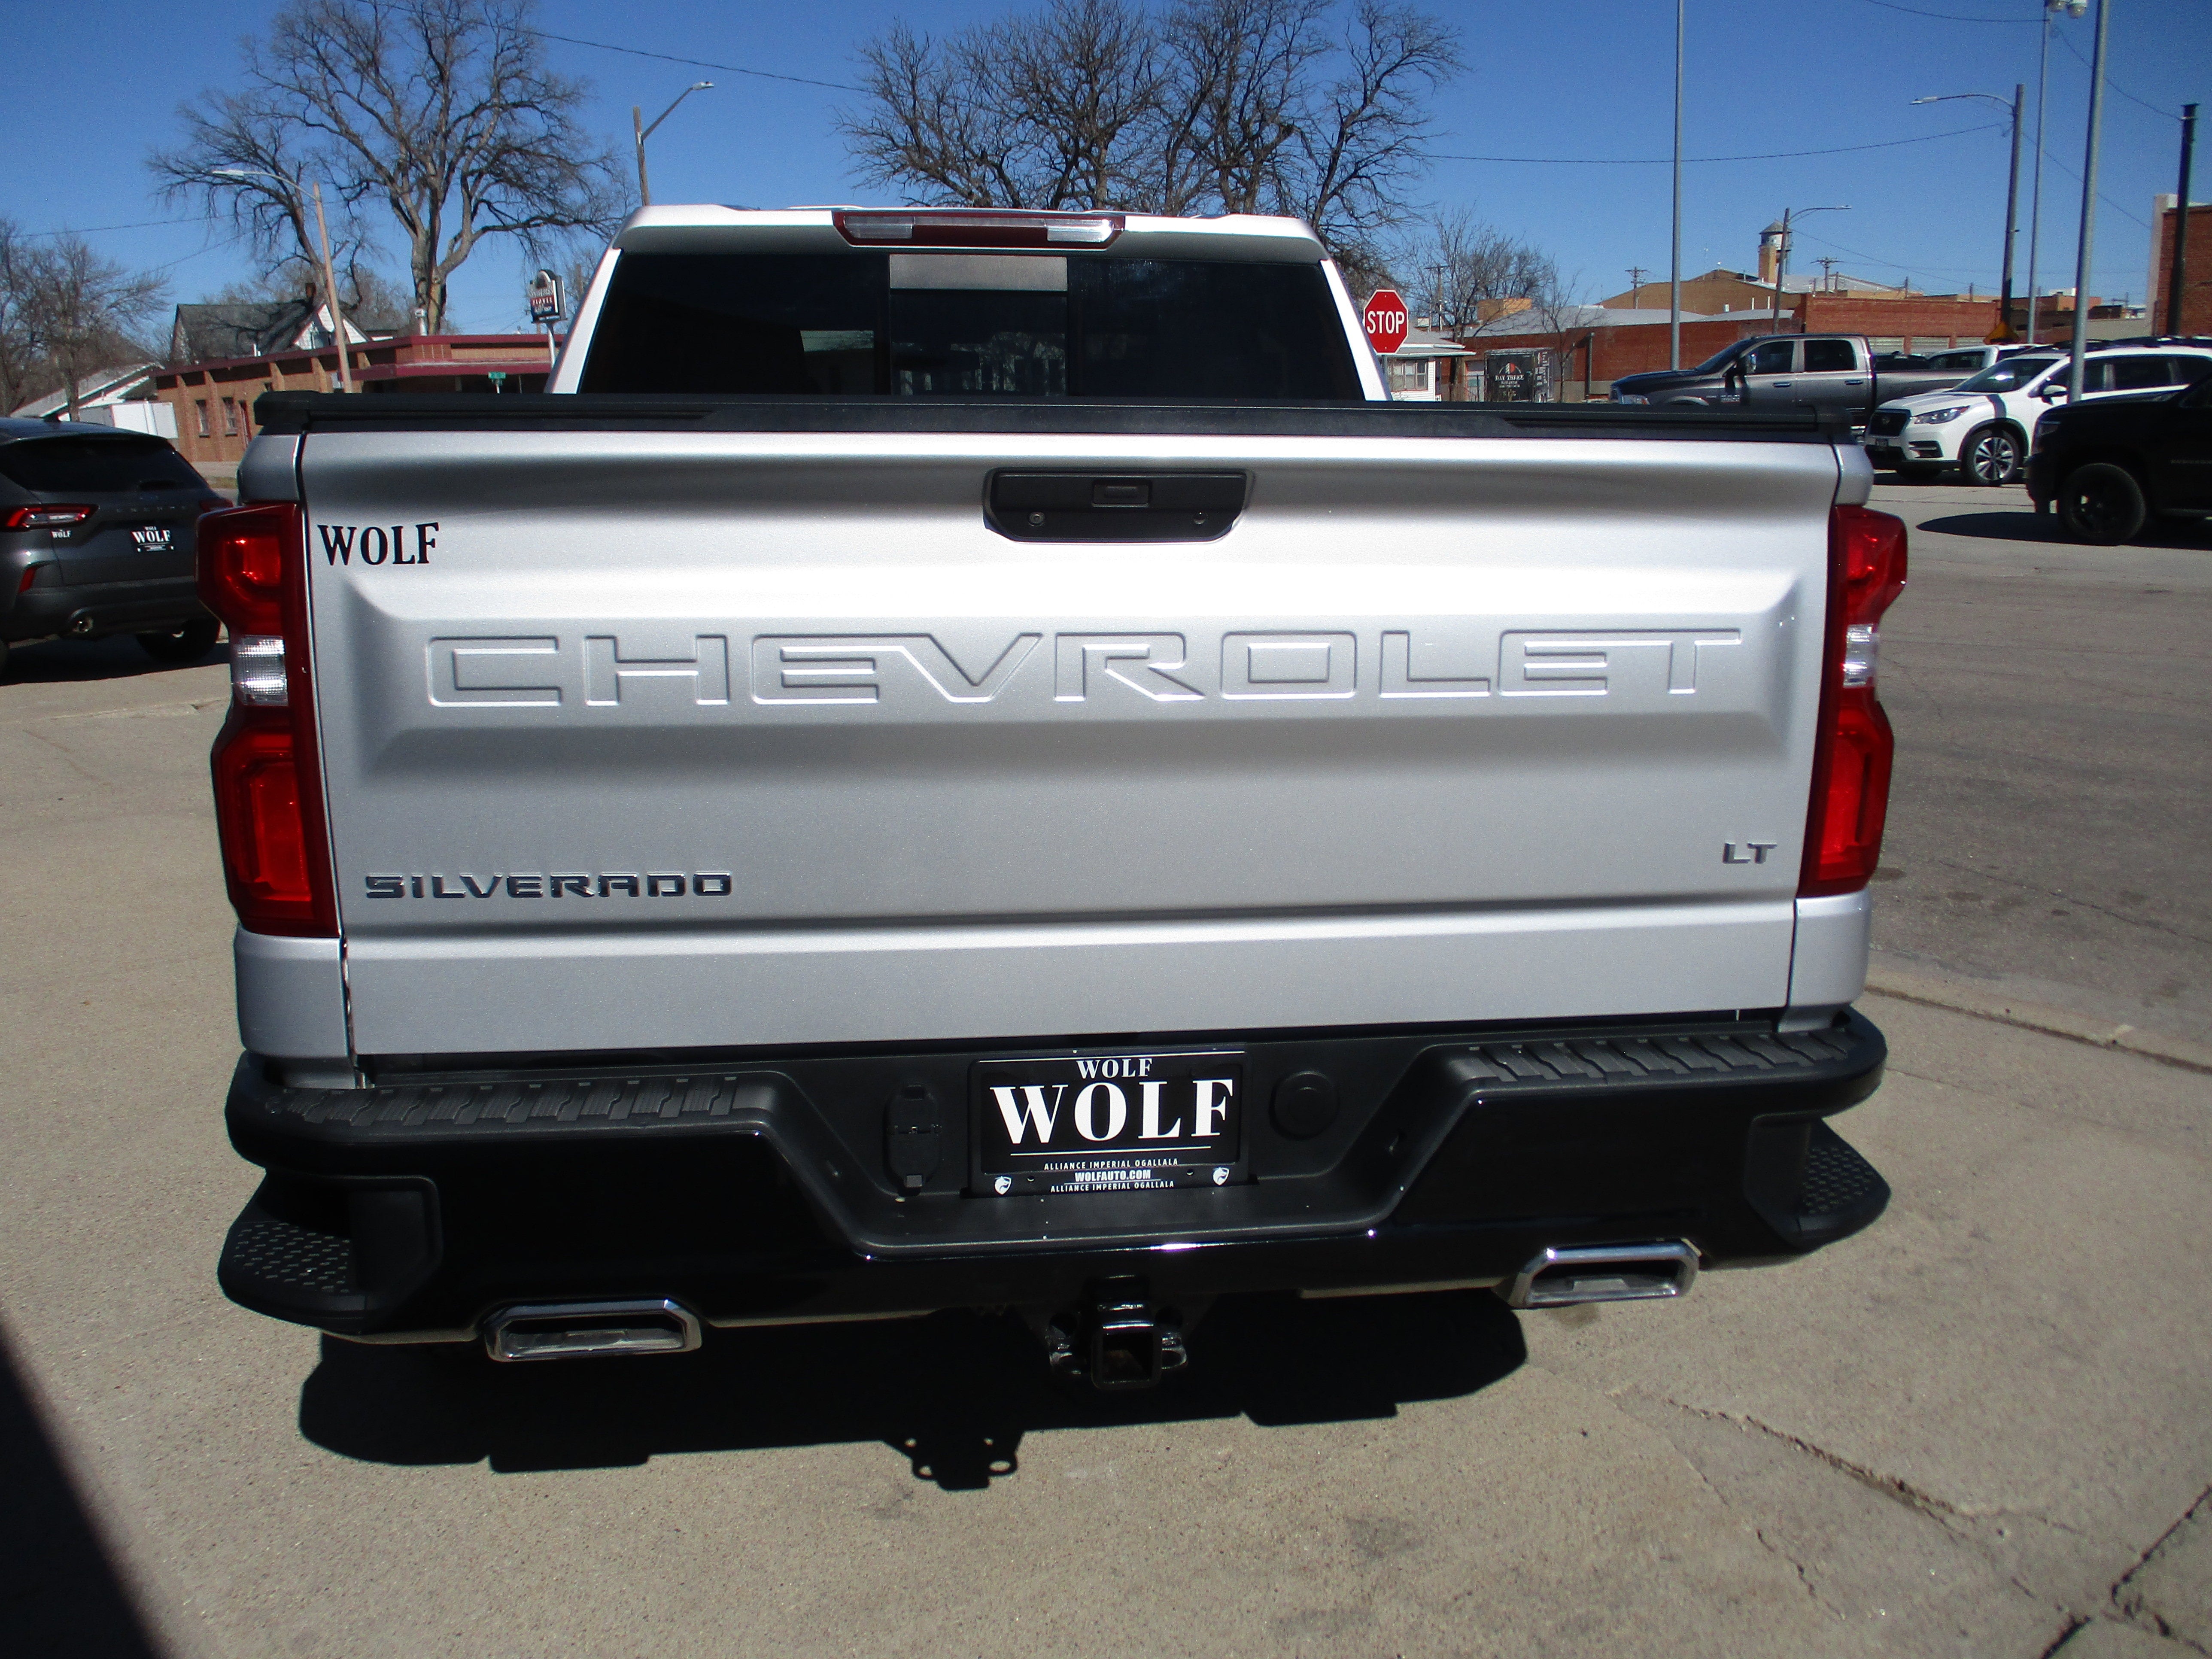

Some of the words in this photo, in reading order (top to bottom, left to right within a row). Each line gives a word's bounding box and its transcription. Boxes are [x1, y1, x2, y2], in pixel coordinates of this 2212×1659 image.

[1367, 310, 1405, 334] STOP
[51, 530, 72, 539] WOLF
[131, 529, 171, 544] WOLF
[317, 522, 439, 565] WOLF
[428, 628, 1742, 707] CHEVROLET
[1723, 842, 1777, 864] LT
[365, 872, 733, 899] SILVERADO
[1076, 1058, 1152, 1079] WOLF
[989, 1079, 1233, 1144] WOLF
[1044, 1161, 1086, 1171] ALLIANCE
[1089, 1160, 1131, 1169] IMPERIAL
[1134, 1158, 1179, 1167] OGALLALA
[1075, 1169, 1152, 1182] WOLFAUTO.COM
[1051, 1184, 1090, 1193] ALLIANCE
[1092, 1182, 1131, 1191] IMPERIAL
[1134, 1180, 1175, 1189] OGALLALA
